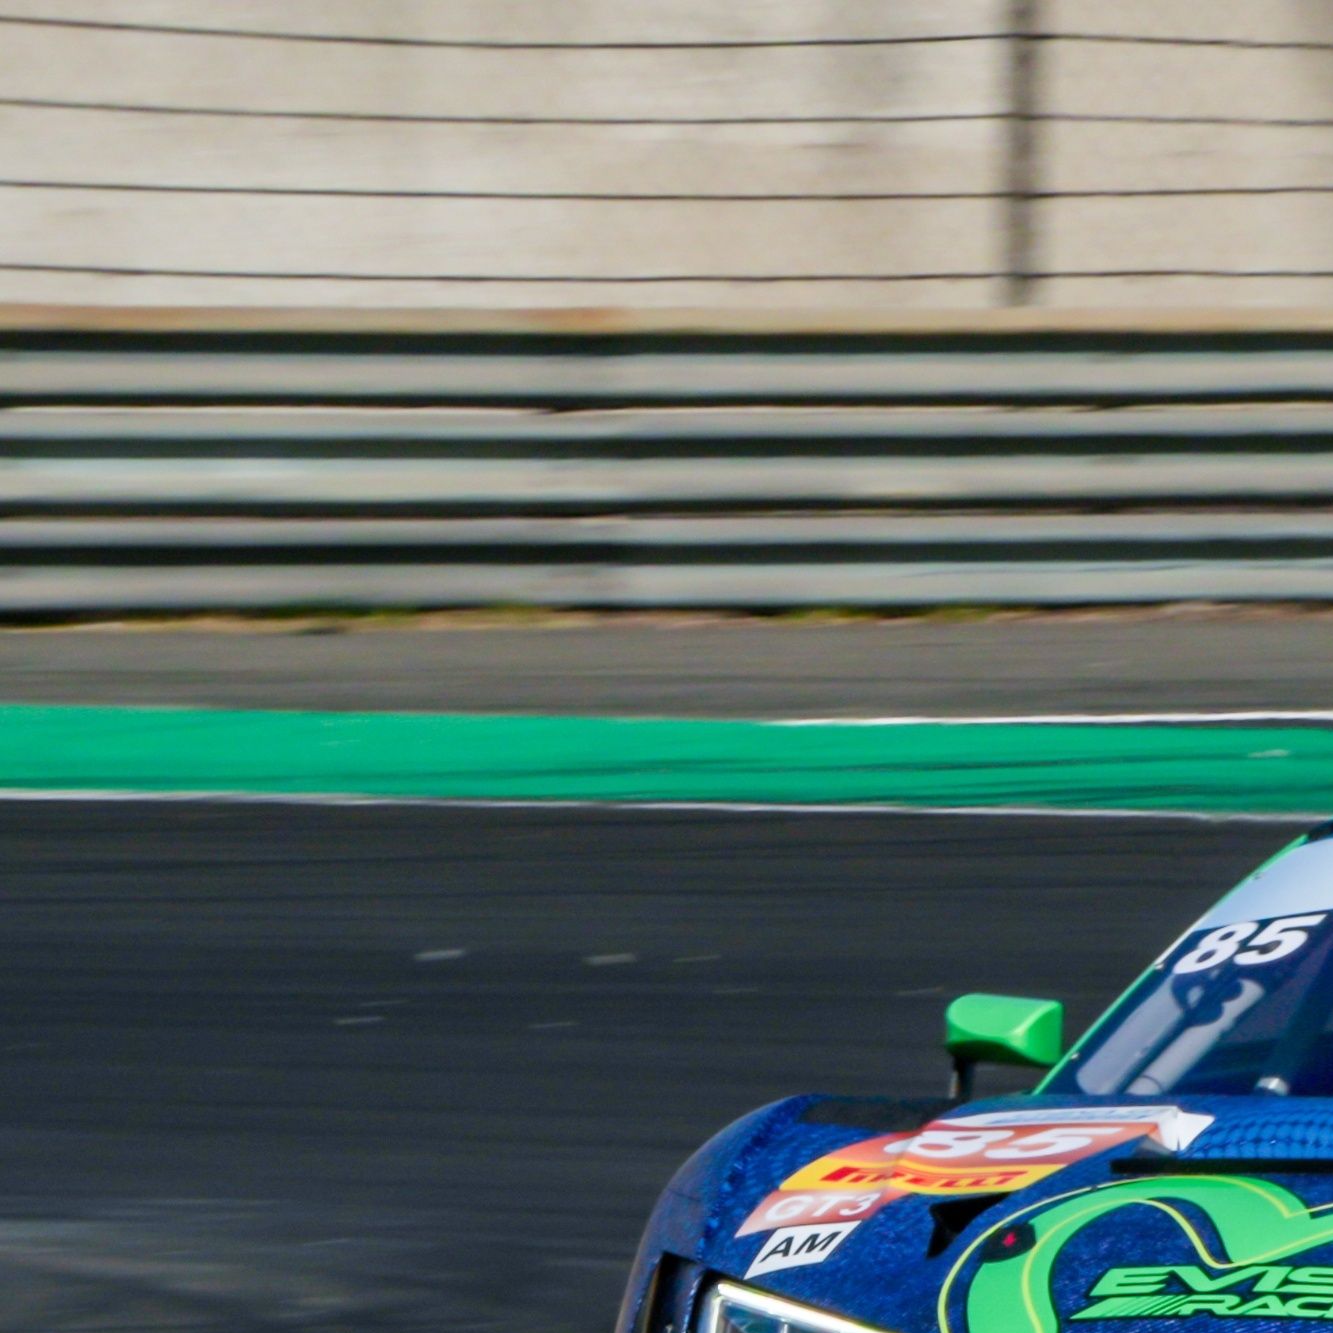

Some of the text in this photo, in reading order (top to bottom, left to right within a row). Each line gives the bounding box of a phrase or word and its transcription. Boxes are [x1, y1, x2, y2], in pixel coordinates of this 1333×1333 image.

[1172, 913, 1328, 974] 85
[883, 1127, 1126, 1160] 85
[819, 1165, 1029, 1189] PIRELLI
[764, 1190, 882, 1222] GT3
[760, 1229, 842, 1263] AM
